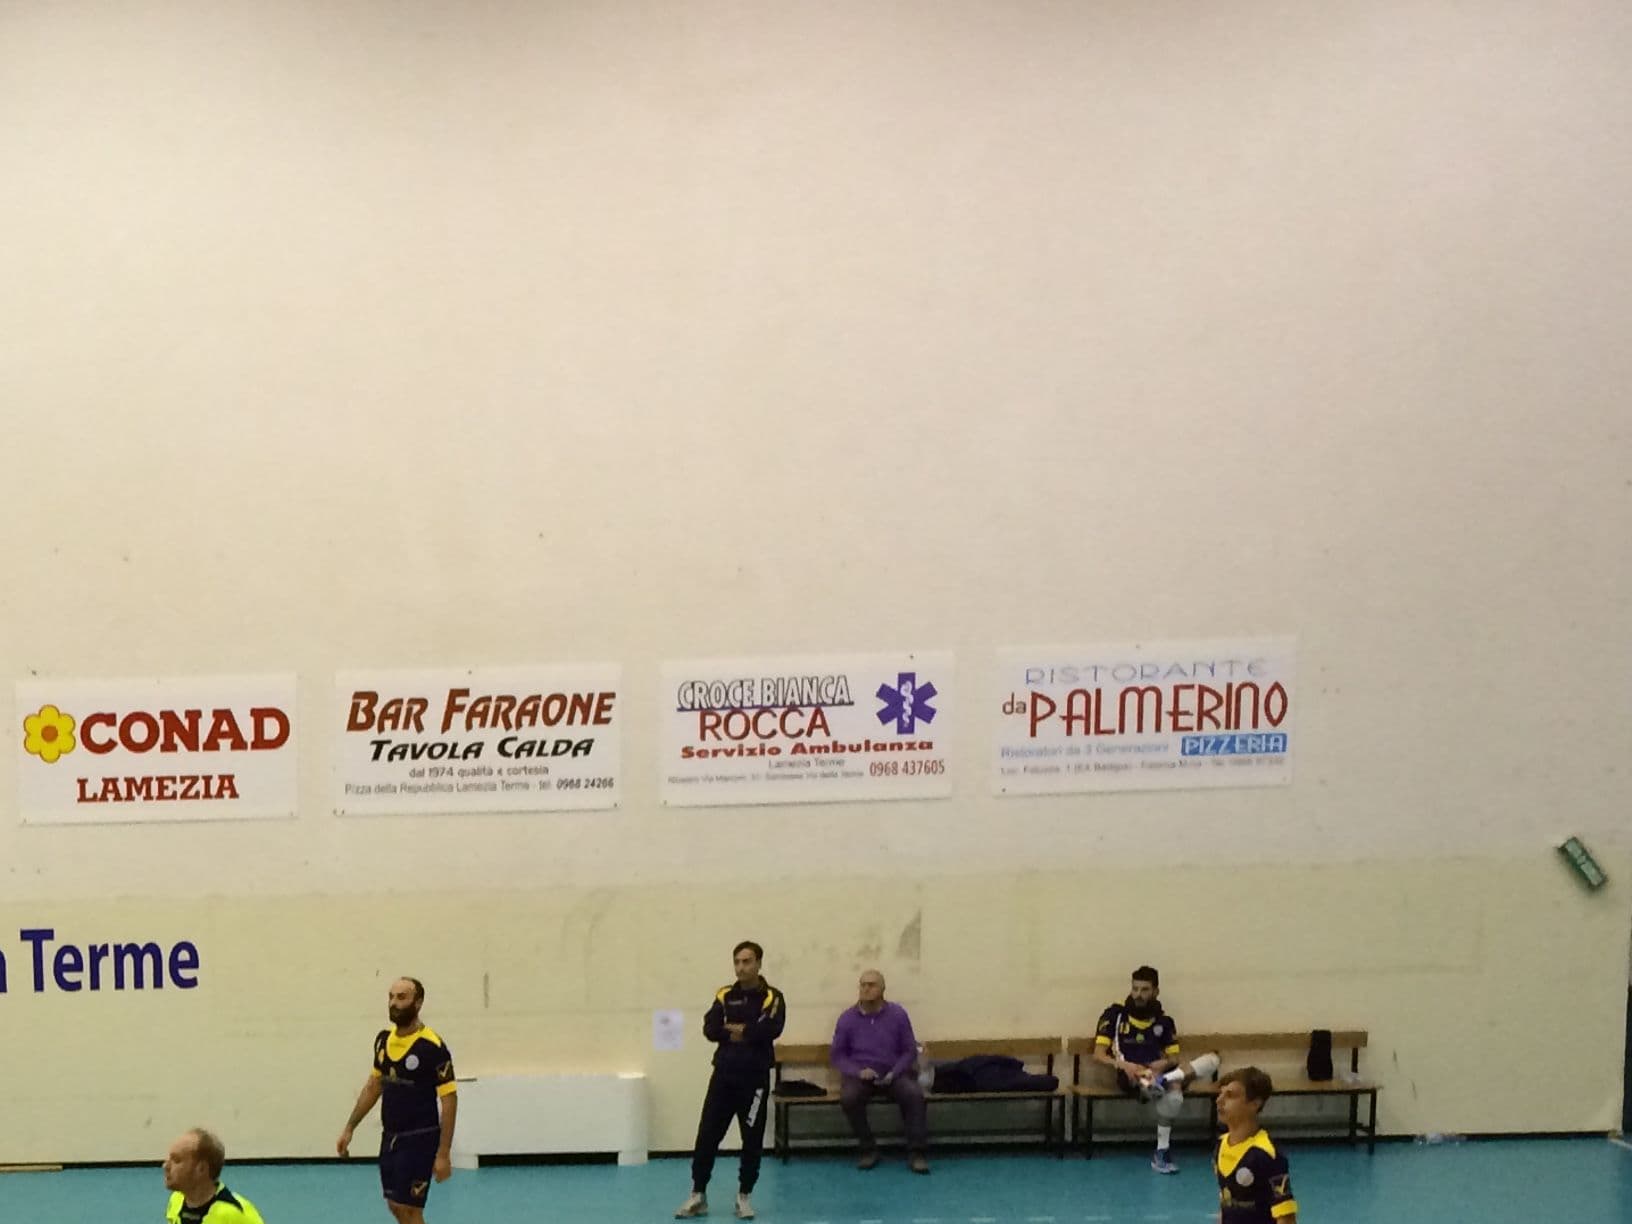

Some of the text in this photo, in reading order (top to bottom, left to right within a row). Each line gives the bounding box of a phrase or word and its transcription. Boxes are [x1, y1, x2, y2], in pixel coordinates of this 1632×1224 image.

[1025, 658, 1268, 684] RISTORANTE
[677, 675, 852, 709] CROCE BIANCA
[1002, 680, 1288, 737] da PALMERINO
[80, 707, 290, 755] CONAD
[699, 707, 831, 742] ROCCA
[681, 739, 934, 759] Servizio Ambulanza
[1183, 734, 1285, 755] PIZZERIA
[409, 768, 425, 778] dal
[429, 766, 454, 777] 1974
[506, 765, 549, 776] cortesia
[869, 759, 945, 777] 0968 437605
[76, 774, 239, 803] LAMEZIA
[20, 928, 200, 992] Terme
